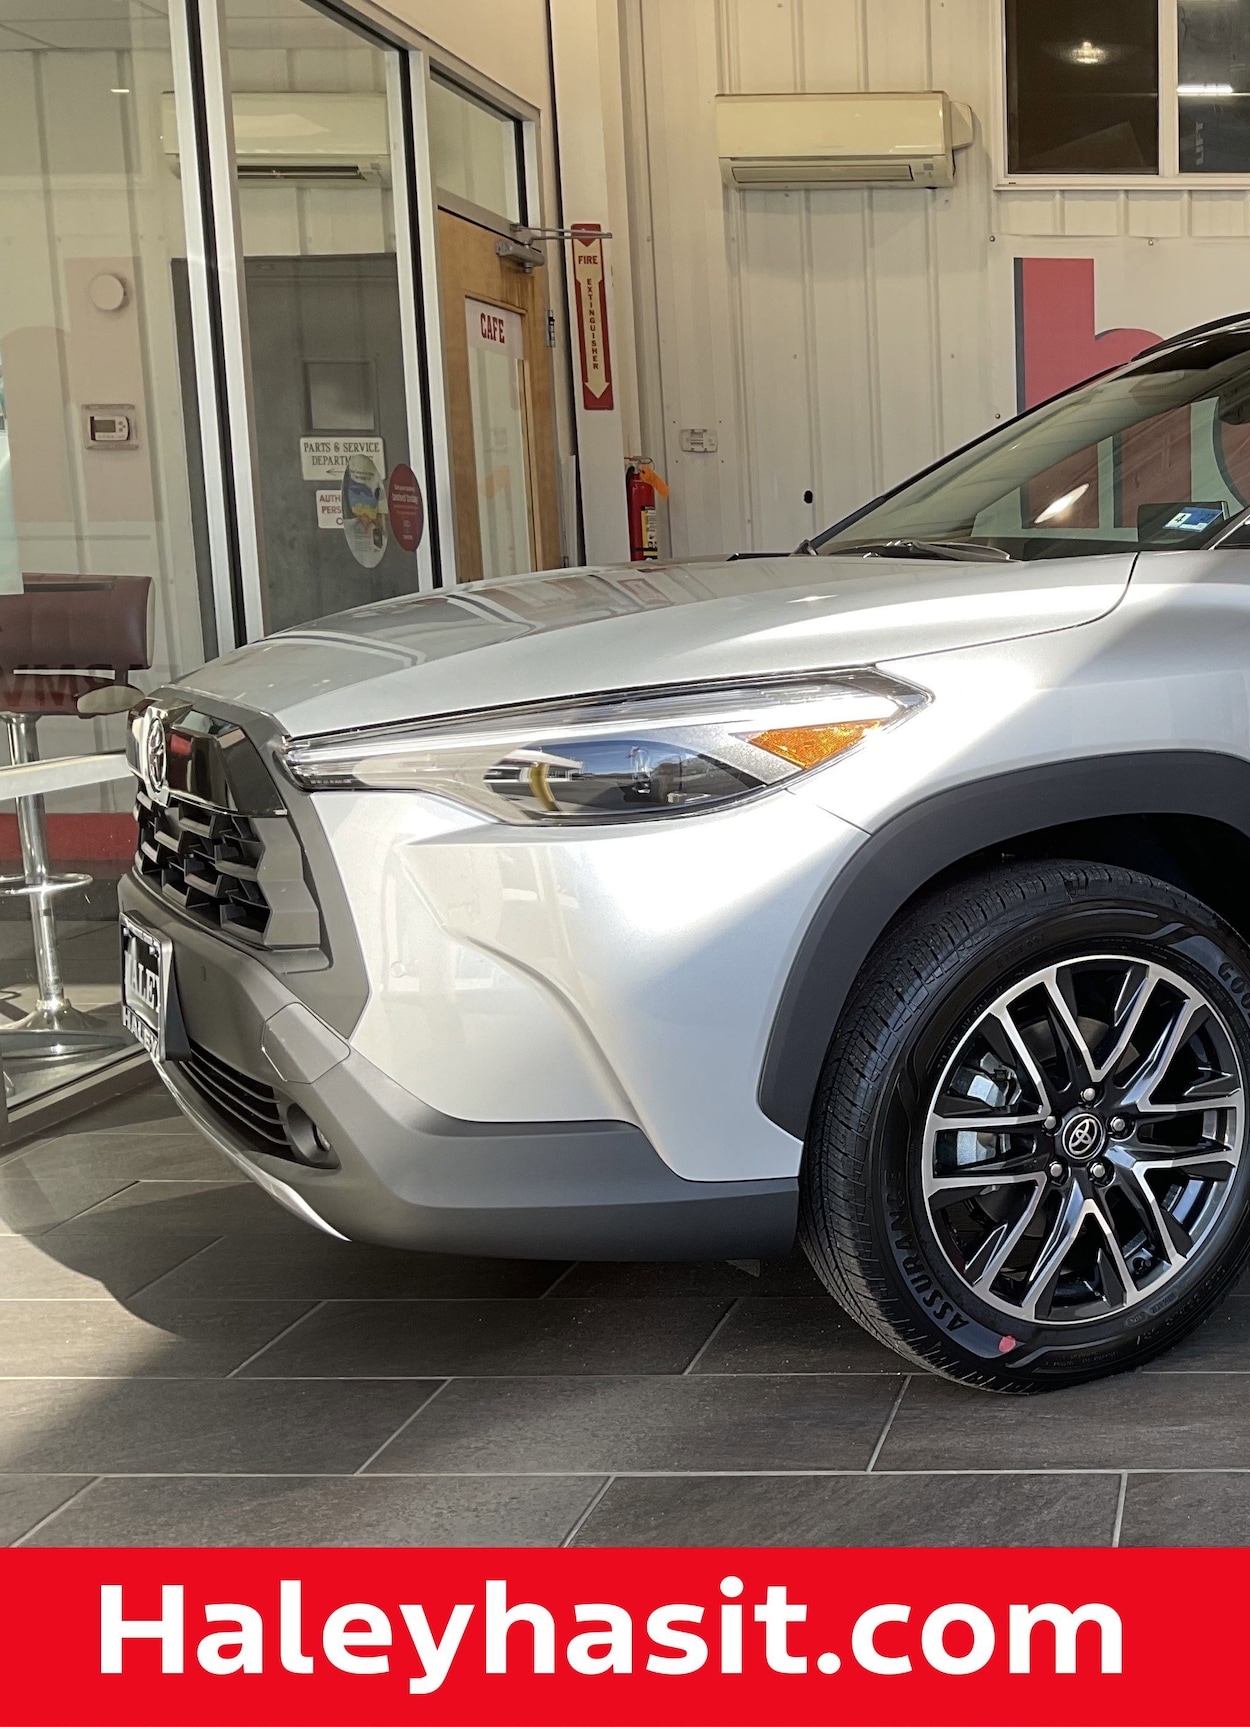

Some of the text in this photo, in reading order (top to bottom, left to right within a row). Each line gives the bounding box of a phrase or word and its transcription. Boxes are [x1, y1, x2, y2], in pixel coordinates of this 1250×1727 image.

[578, 255, 598, 265] FIRE
[480, 312, 505, 344] CAFE
[586, 278, 600, 370] EXTINGUISHER
[303, 442, 380, 453] PARTS & SERVICE
[123, 1005, 160, 1062] HALEY
